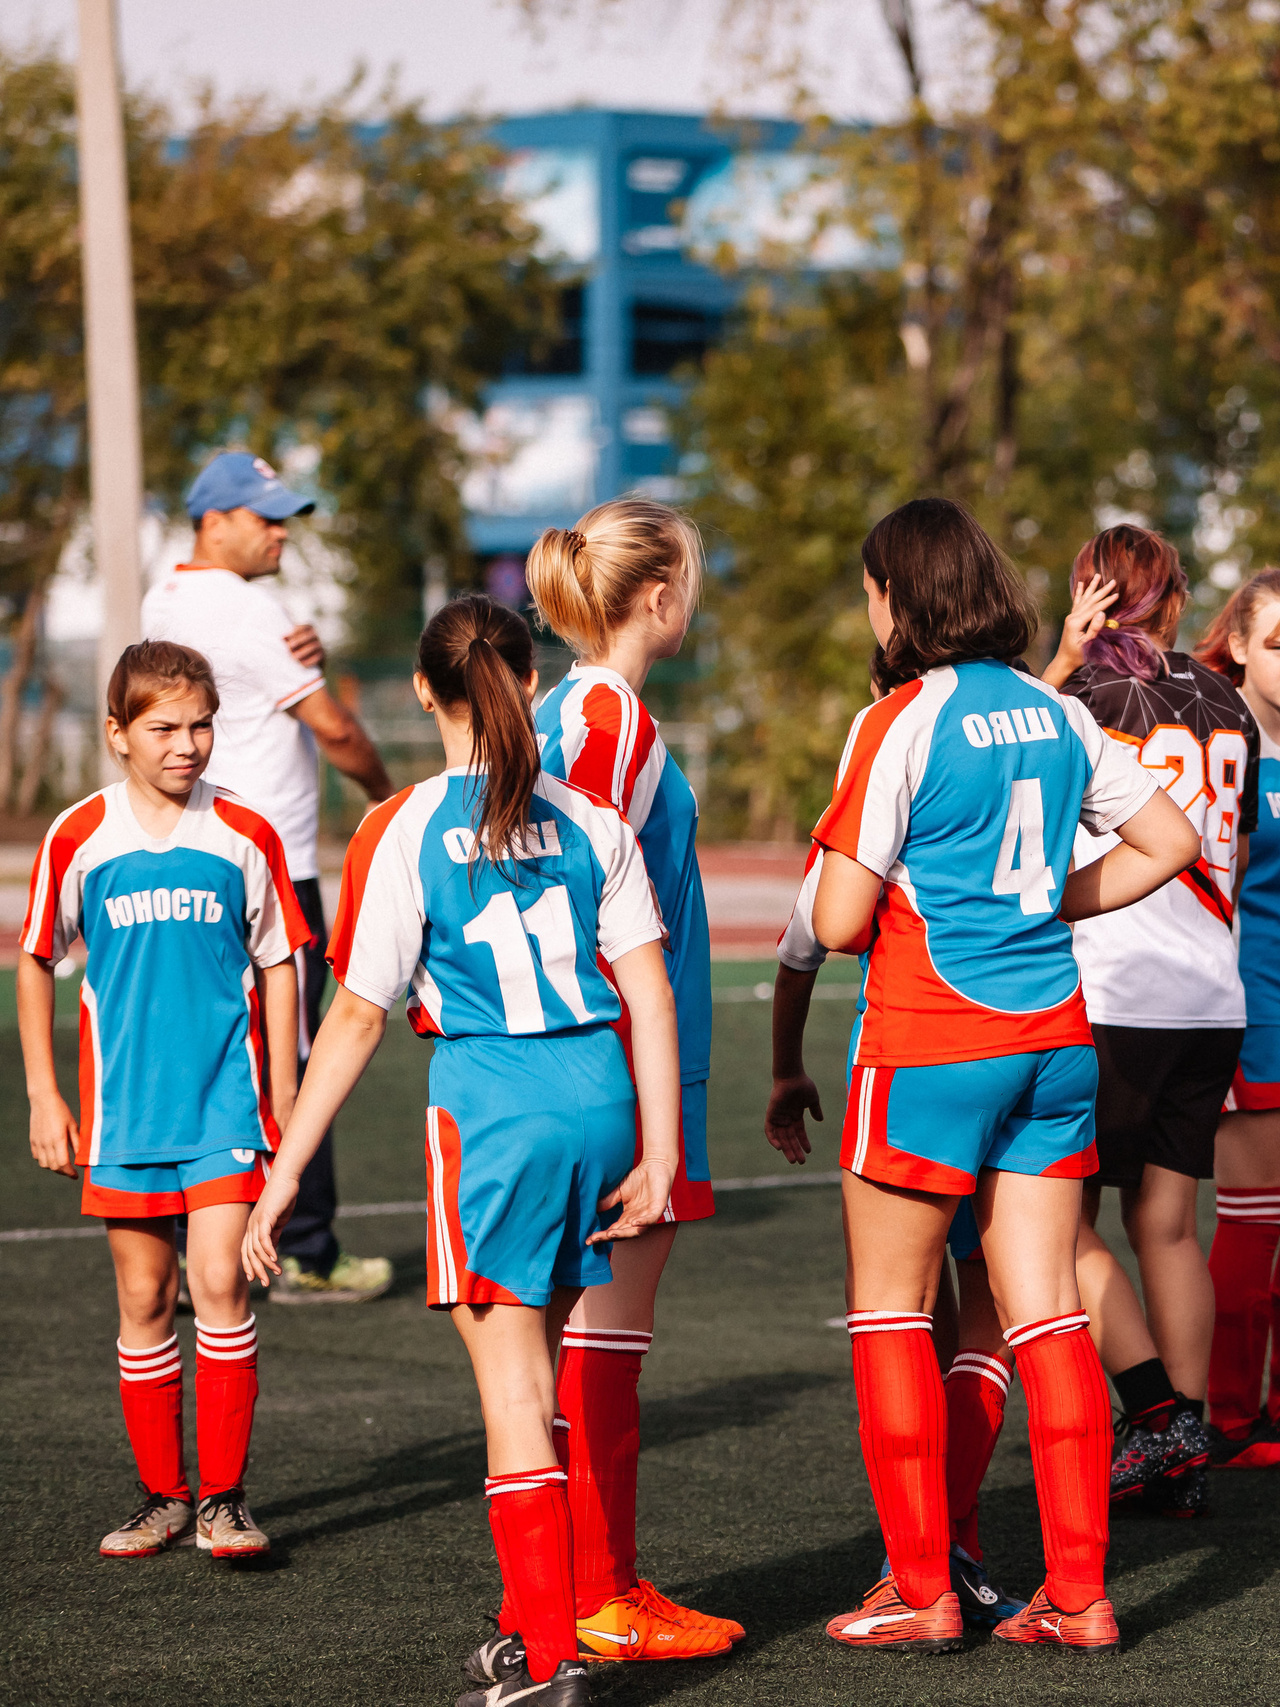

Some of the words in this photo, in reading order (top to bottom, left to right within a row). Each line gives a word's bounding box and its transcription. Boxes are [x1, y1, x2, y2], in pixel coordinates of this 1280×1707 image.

[962, 707, 1059, 748] ОЯШ
[992, 777, 1057, 915] 4
[104, 887, 224, 930] ЮНОСТЬ
[462, 884, 597, 1034] 11
[657, 1633, 675, 1641] CR7
